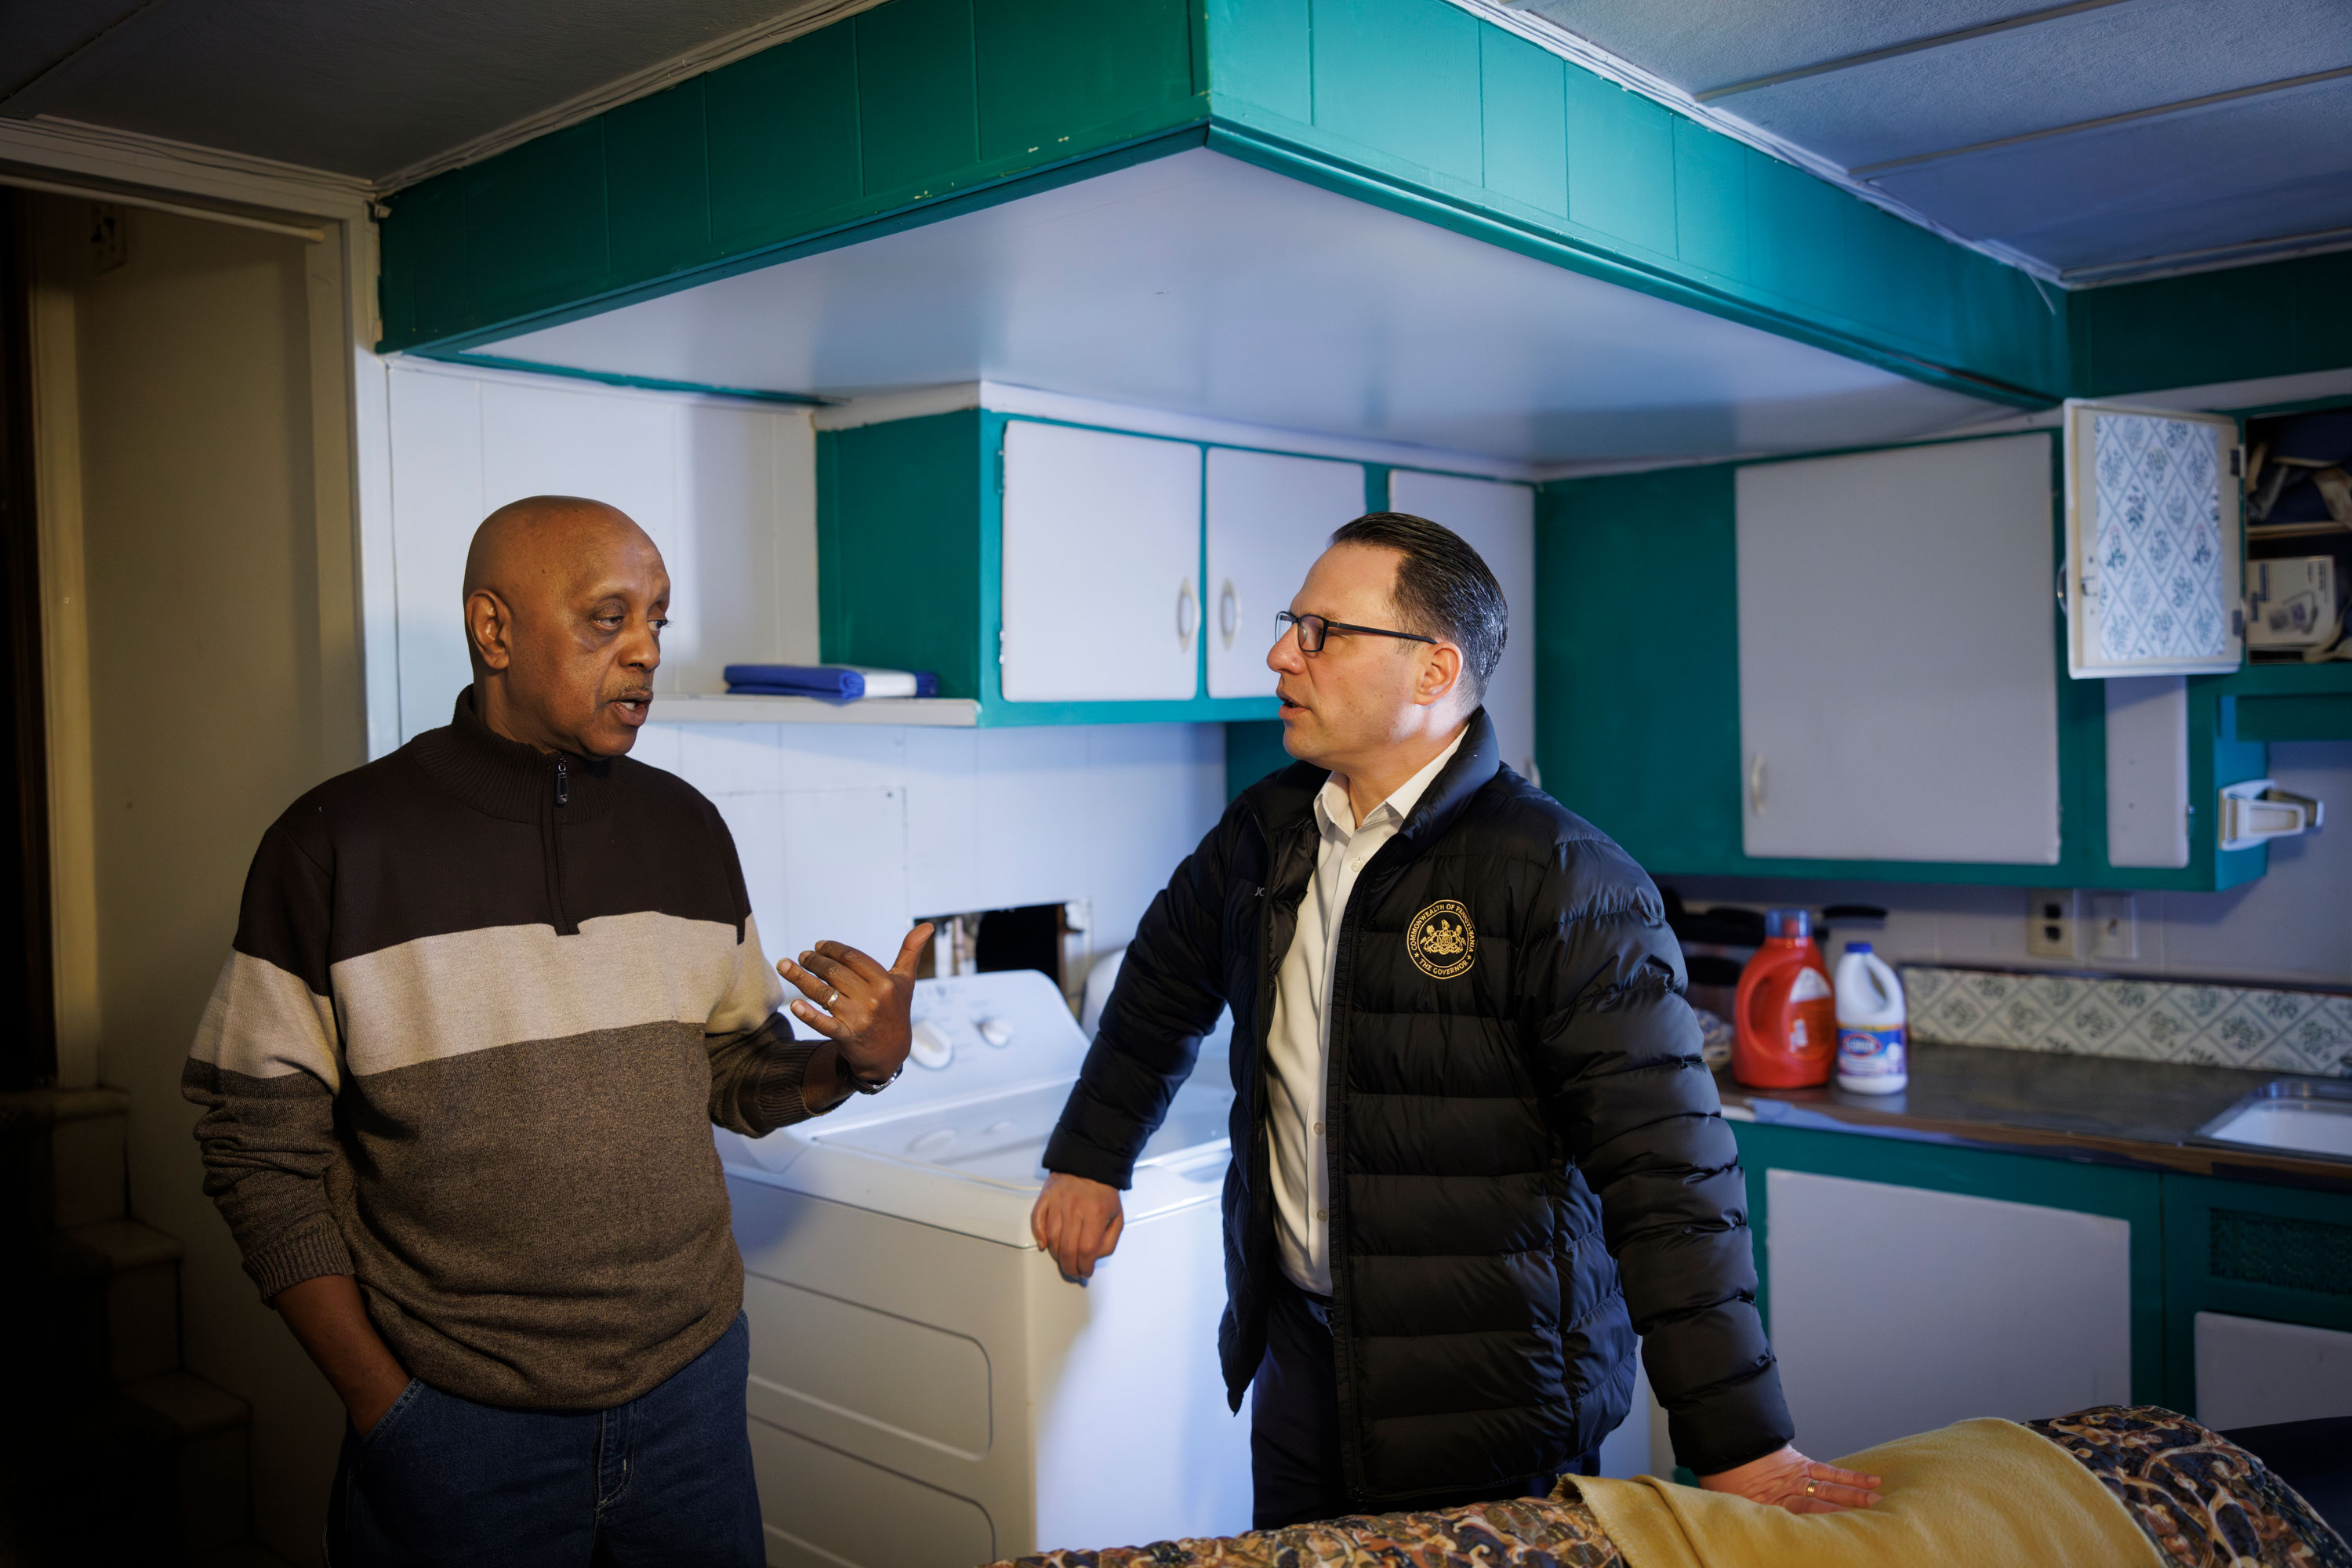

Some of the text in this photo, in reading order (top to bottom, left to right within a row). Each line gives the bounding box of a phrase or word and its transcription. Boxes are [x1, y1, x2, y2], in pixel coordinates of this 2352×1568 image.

[1410, 904, 1444, 951] COMMONWEALTH
[1455, 906, 1475, 953] PENNSYLVANIA
[1419, 958, 1468, 975] THE GOVERNOR
